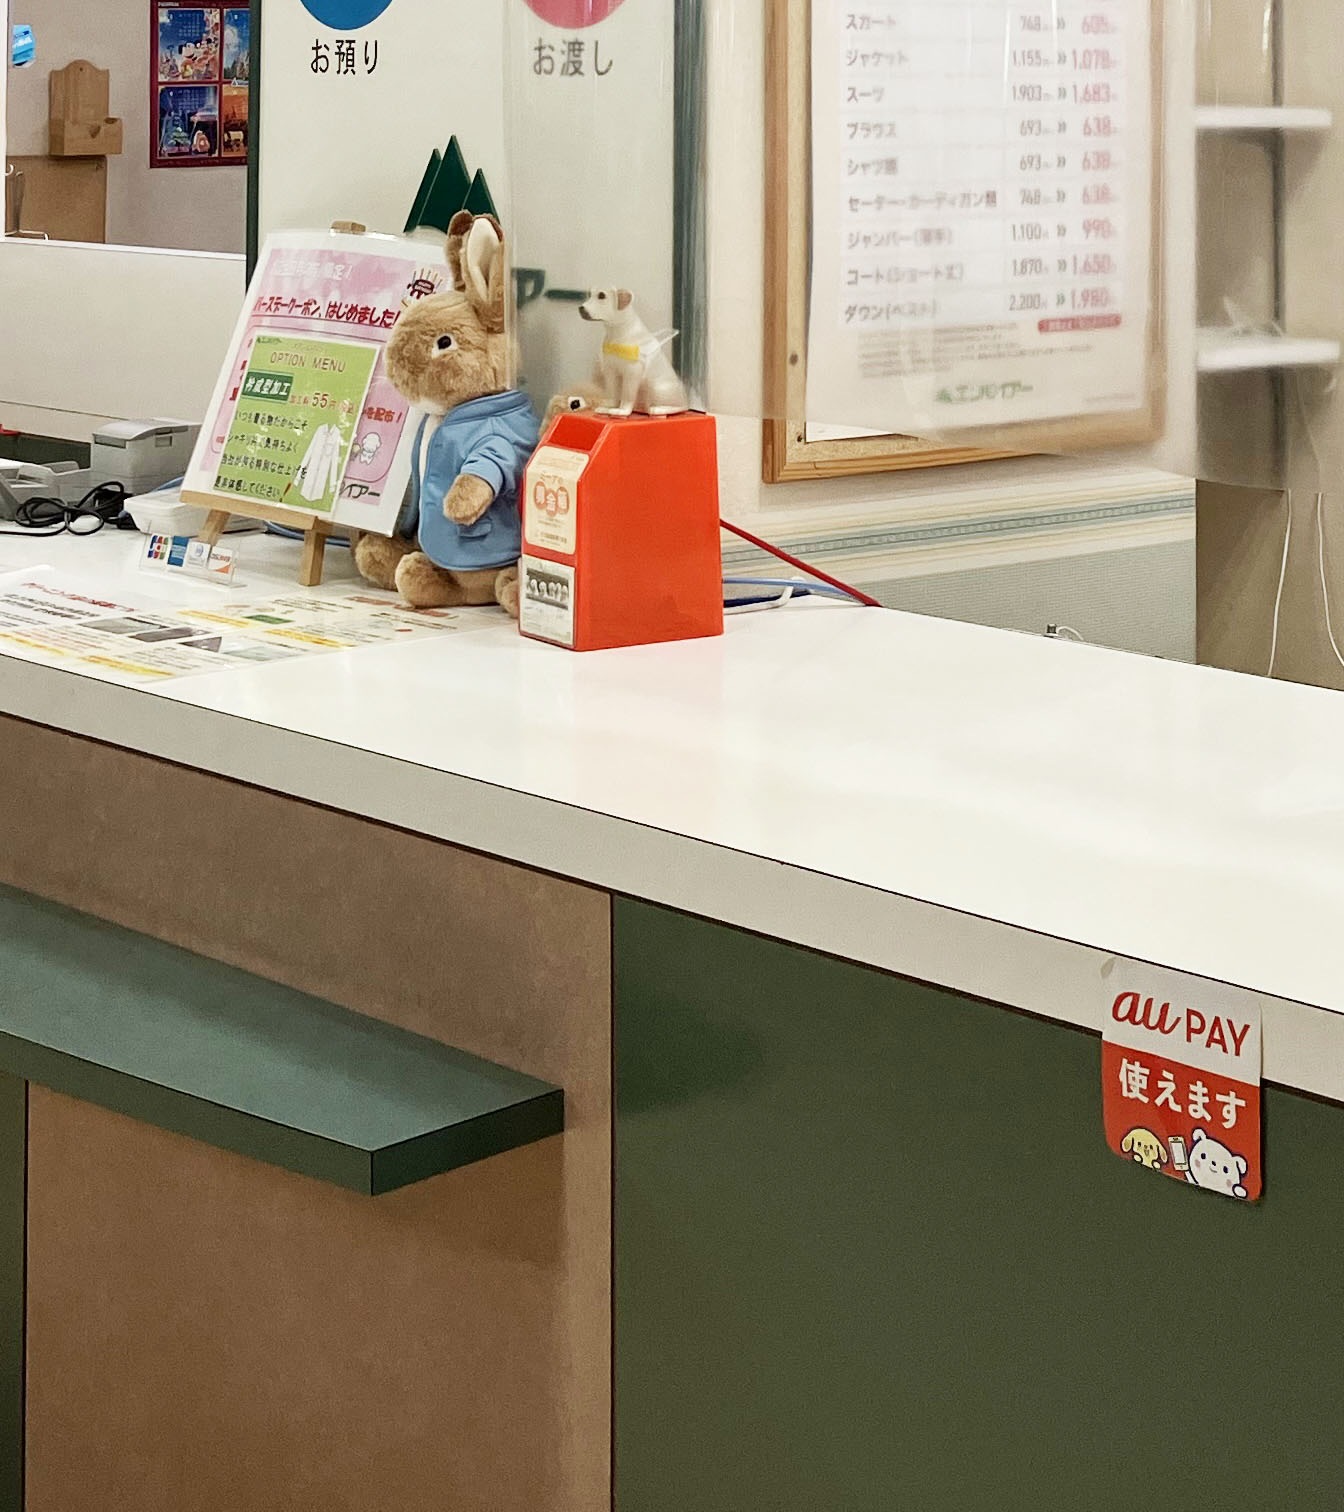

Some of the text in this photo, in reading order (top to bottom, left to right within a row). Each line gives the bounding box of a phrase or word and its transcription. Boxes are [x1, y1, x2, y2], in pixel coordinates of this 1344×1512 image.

[310, 39, 380, 75] お預り
[533, 39, 613, 77] お渡し
[270, 352, 346, 373] OPTION MENU
[1112, 992, 1250, 1057] au PAY
[1119, 1058, 1246, 1129] 使えます
